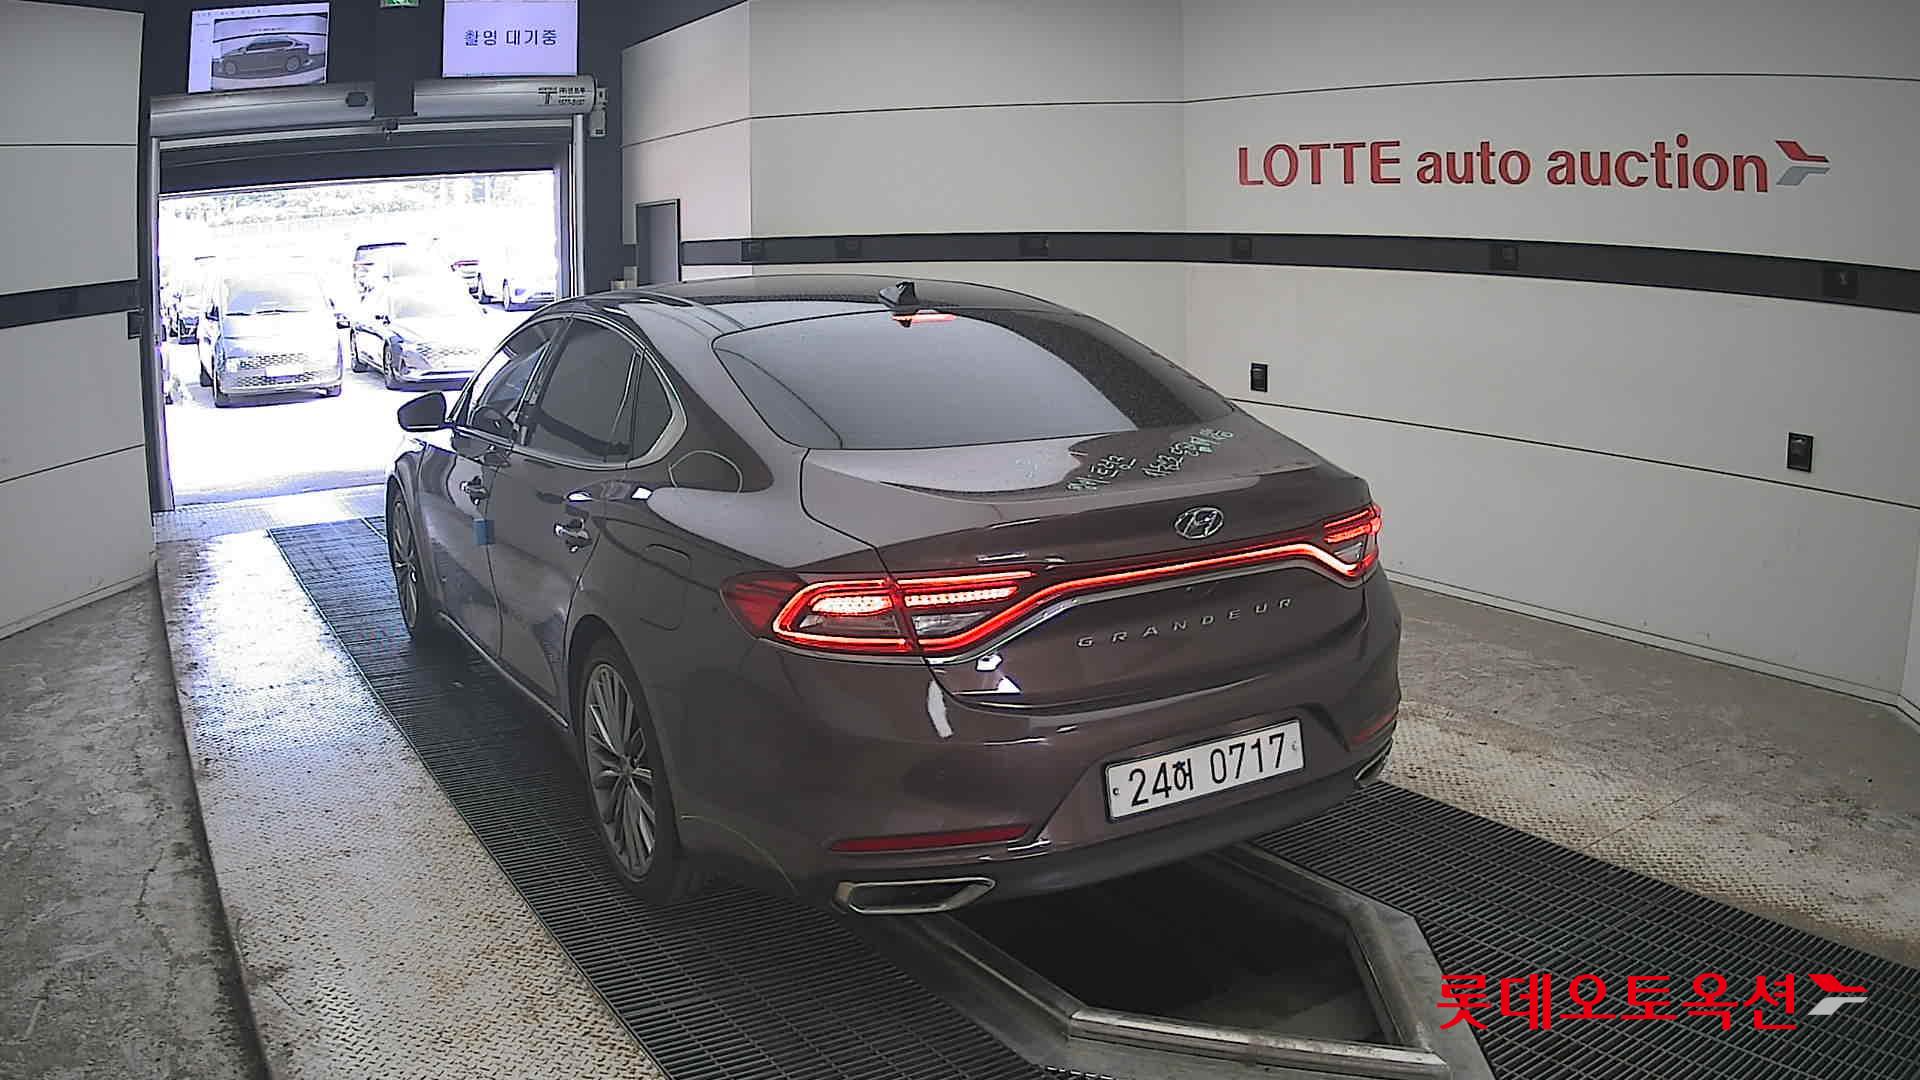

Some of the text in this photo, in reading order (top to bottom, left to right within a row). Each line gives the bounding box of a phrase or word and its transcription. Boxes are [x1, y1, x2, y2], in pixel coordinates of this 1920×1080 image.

[506, 29, 557, 46] 대기중
[1239, 133, 1769, 193] LOTTE auto auction
[1077, 597, 1293, 648] GRANDEUR
[1128, 732, 1286, 807] 24허 0717
